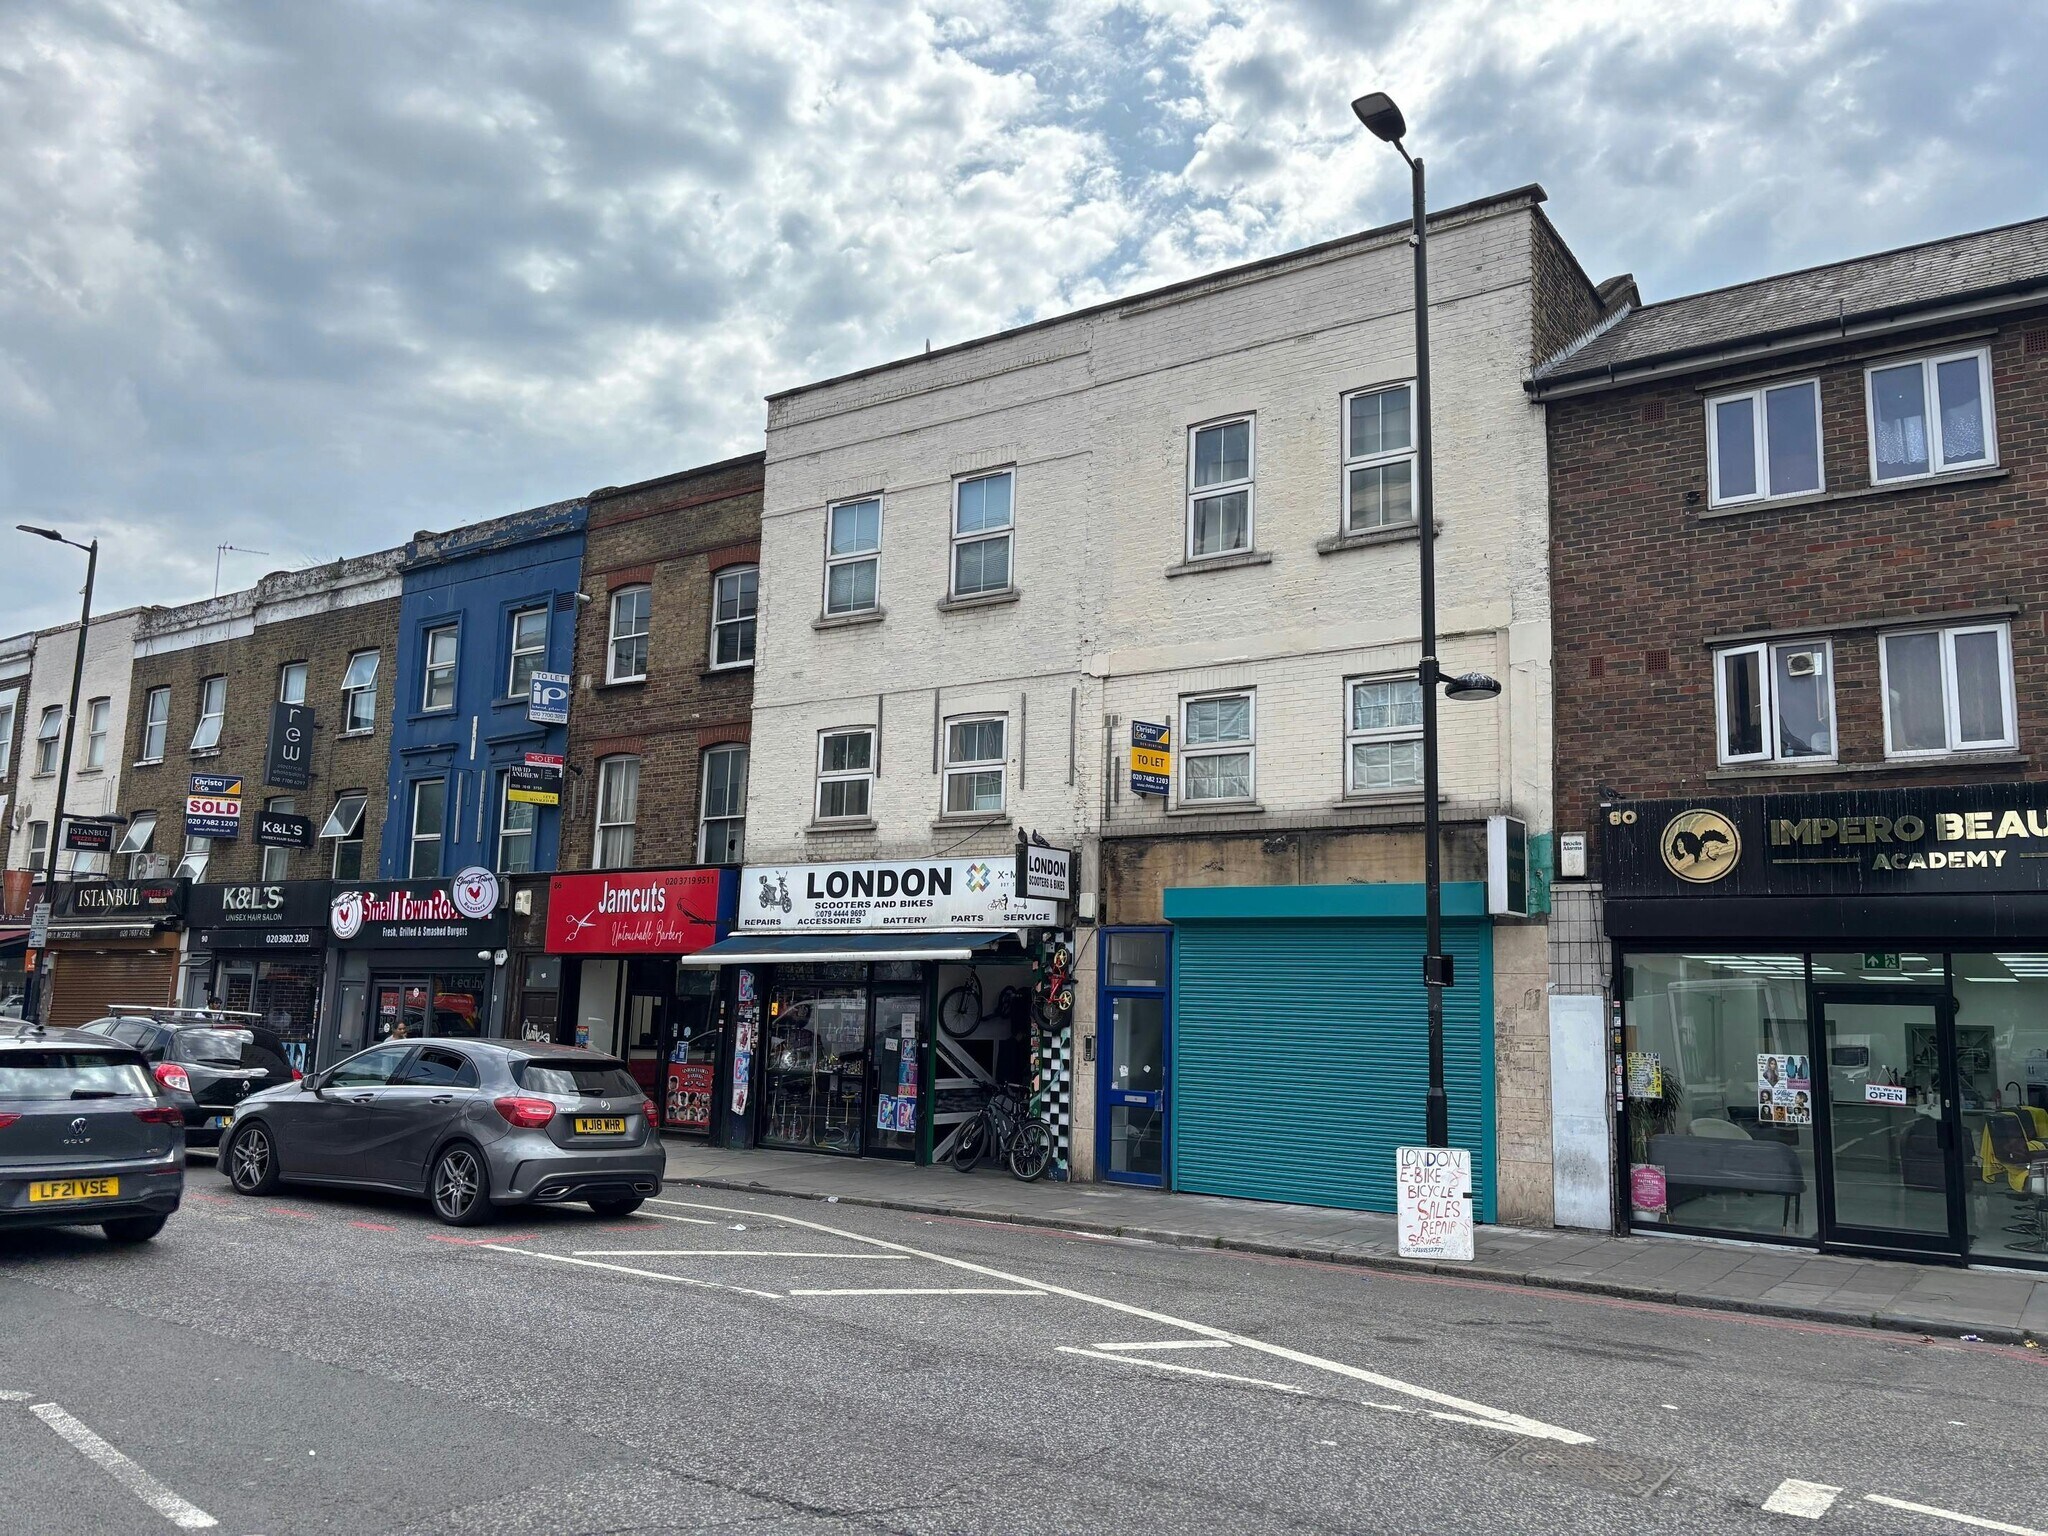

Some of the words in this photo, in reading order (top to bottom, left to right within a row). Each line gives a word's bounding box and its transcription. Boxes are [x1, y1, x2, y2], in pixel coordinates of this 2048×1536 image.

[550, 674, 565, 682] LET
[282, 708, 301, 761] rew
[1136, 725, 1156, 735] Christo
[1137, 754, 1148, 765] TO
[1150, 757, 1165, 767] LET
[194, 778, 223, 787] Christo
[1132, 773, 1142, 781] 020
[1143, 775, 1155, 783] 7482
[1156, 777, 1169, 785] 1203
[189, 800, 239, 815] SOLD
[220, 820, 238, 828] 1203
[262, 821, 303, 836] K&L'S
[1770, 814, 1925, 846] IMPERO
[1935, 808, 2048, 841] BEAU
[69, 827, 110, 838] ISTANBUL
[93, 836, 106, 844] BAR
[1029, 855, 1066, 878] LONDON
[1872, 849, 2007, 871] ACADEMY
[456, 875, 475, 887] Small
[475, 872, 493, 882] Town
[553, 881, 562, 889] 86
[665, 877, 678, 886] 020
[679, 877, 697, 886] 3719
[806, 867, 952, 899] LONDON
[1029, 874, 1049, 889] SCOOTERS
[1053, 879, 1065, 891] BIKES
[78, 887, 140, 907] ISTANBUL
[222, 886, 284, 910] K&L'S
[598, 880, 667, 914] Jamcuts
[362, 890, 397, 922] Small
[398, 889, 433, 920] Town
[814, 900, 871, 909] SCOOTERS
[873, 900, 897, 909] AND
[900, 899, 934, 908] BIKES
[247, 913, 262, 921] HAIR
[262, 913, 283, 921] SALON
[833, 910, 849, 918] 4444
[883, 916, 928, 924] BATTERY
[950, 914, 985, 922] PARTS
[1003, 913, 1050, 921] SERVICE
[744, 918, 782, 926] REPAIRS
[797, 917, 862, 925] ACCESSORIES
[382, 927, 398, 937] Fresh,
[399, 926, 417, 937] Grilled
[417, 927, 421, 936] &
[422, 926, 446, 936] Smashed
[447, 925, 468, 938] Burgers
[611, 921, 654, 947] Untouchable
[654, 919, 684, 947] Barbers
[294, 934, 310, 943] 3203
[1869, 1091, 1903, 1102] OPEN
[581, 1119, 603, 1131] WJ18
[604, 1119, 621, 1131] WHR
[1401, 1148, 1462, 1168] LONDON
[1400, 1166, 1442, 1184] E-BIKE
[40, 1182, 76, 1198] LF21
[80, 1180, 109, 1196] VSE
[1408, 1185, 1455, 1199] BICYCLE
[1417, 1199, 1461, 1221] SALES
[1420, 1221, 1457, 1237] REPAIR
[1408, 1234, 1442, 1247] SERVICE
